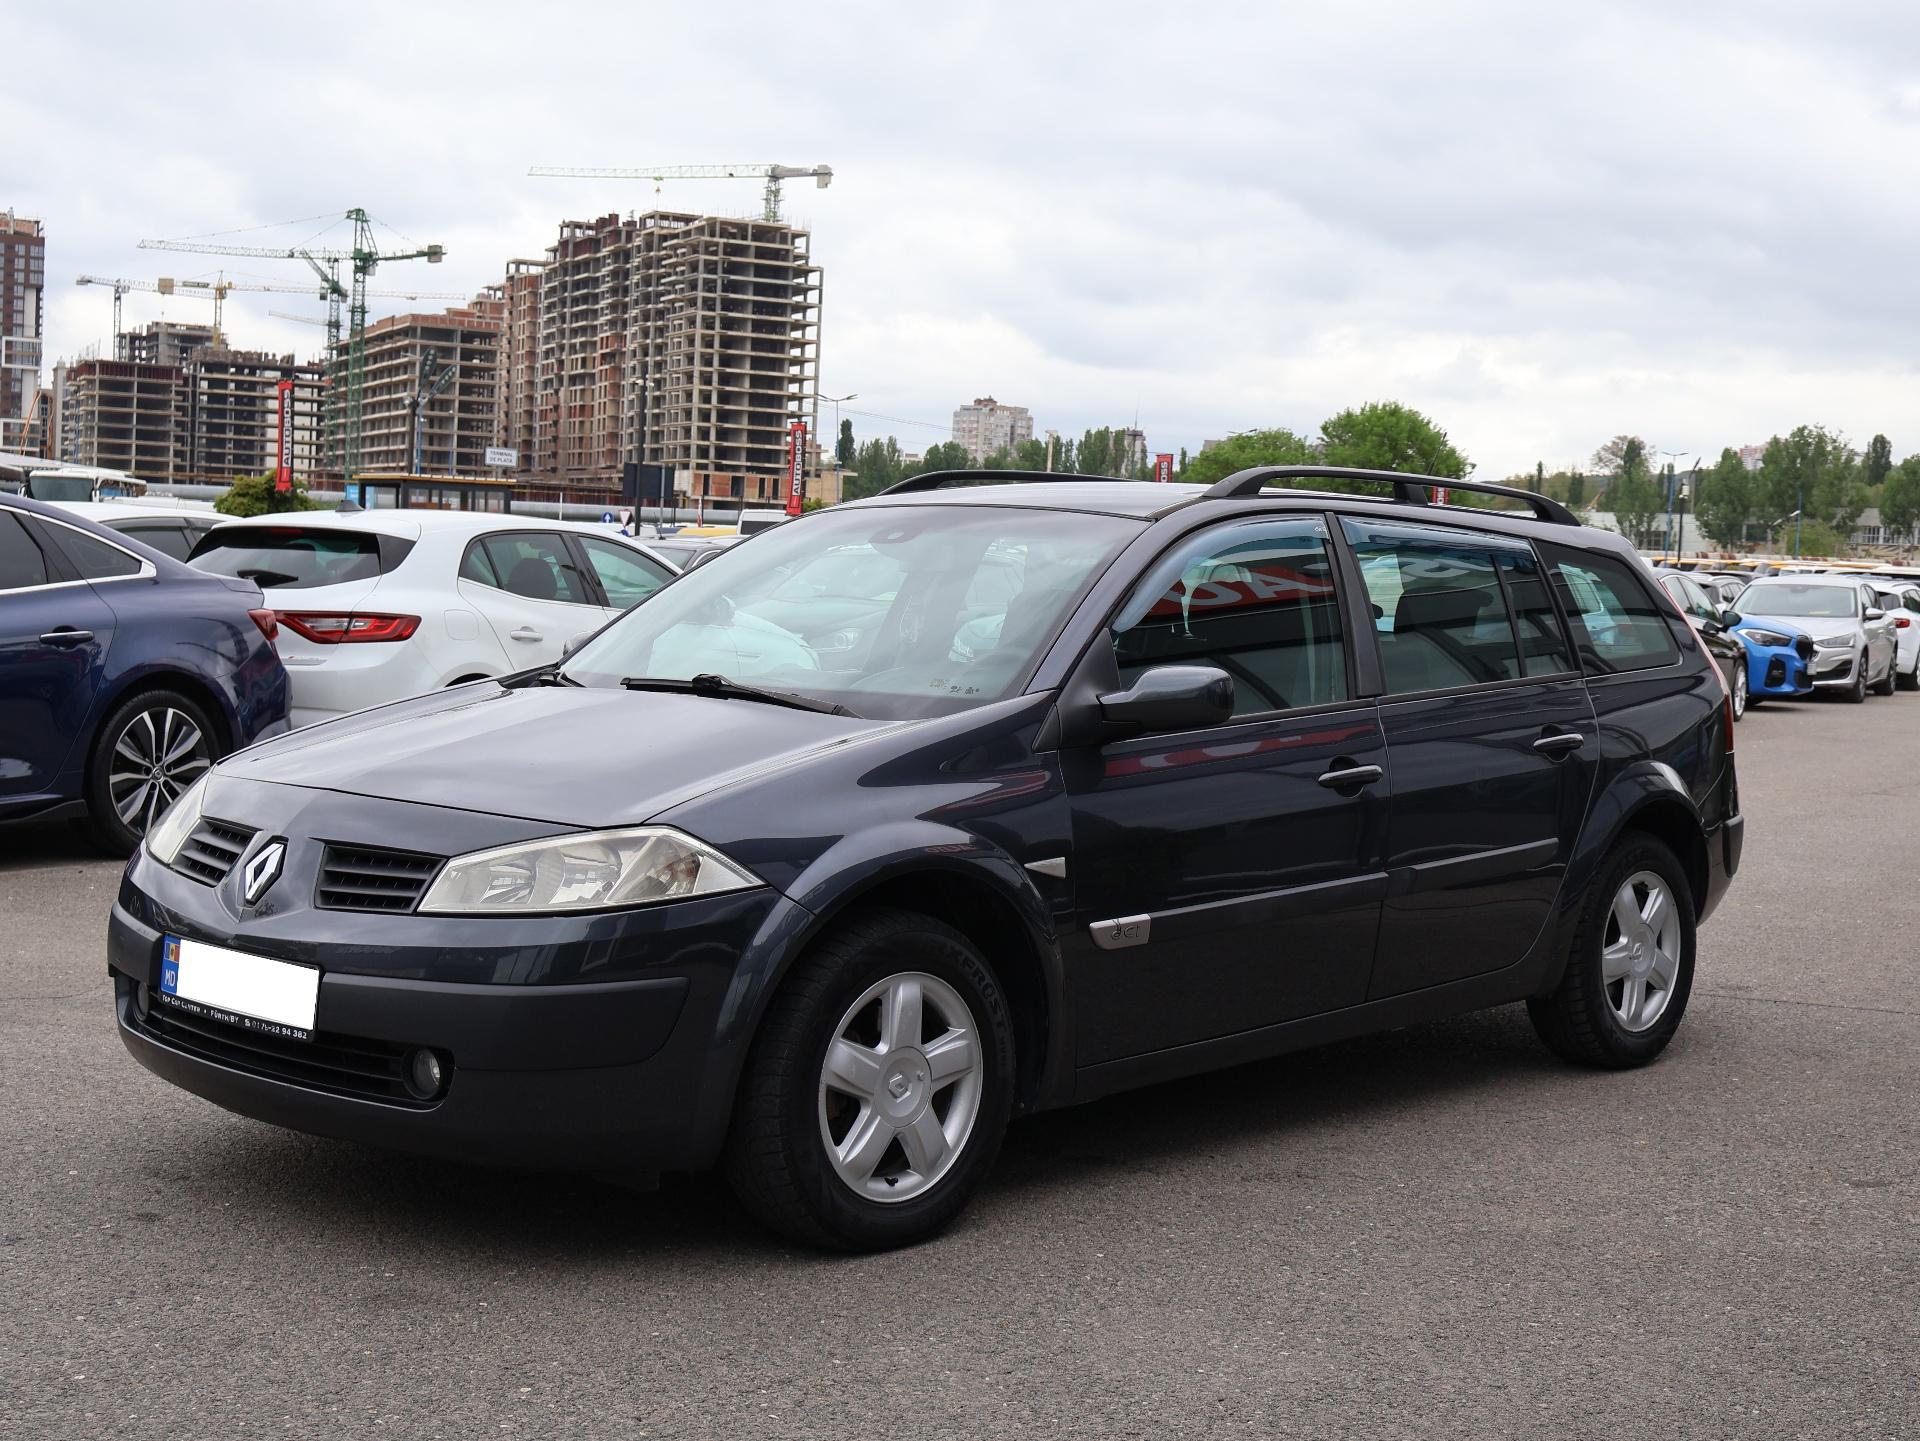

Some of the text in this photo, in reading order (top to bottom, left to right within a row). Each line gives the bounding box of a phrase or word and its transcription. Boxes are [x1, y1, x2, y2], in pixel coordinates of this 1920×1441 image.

[793, 430, 803, 494] AUTOBOSS
[164, 969, 177, 987] MD
[281, 1027, 291, 1036] 94
[292, 1029, 307, 1040] 382
